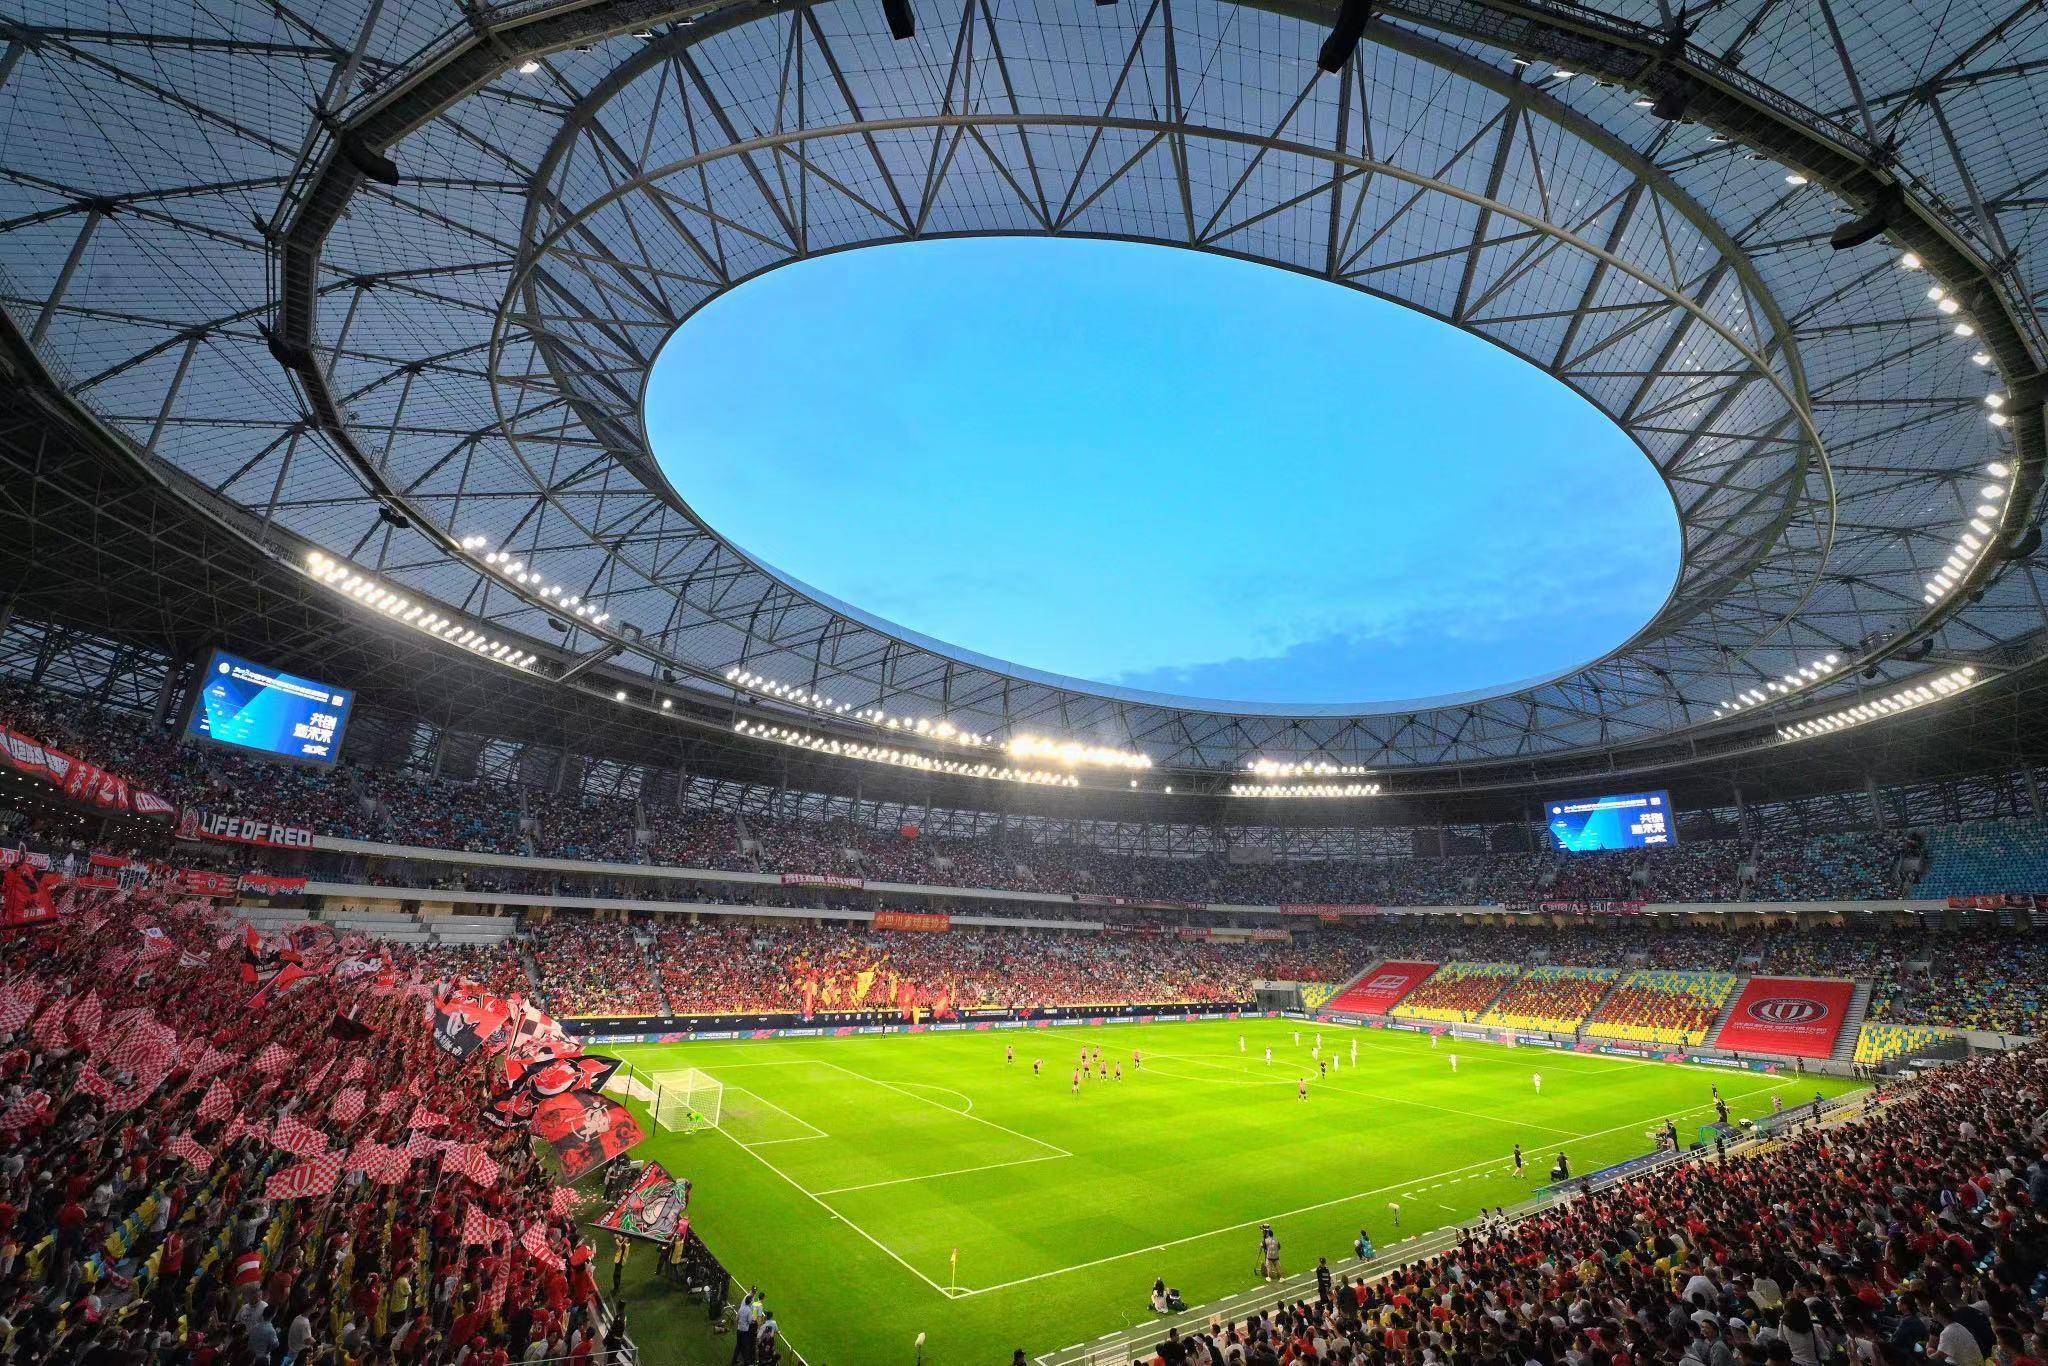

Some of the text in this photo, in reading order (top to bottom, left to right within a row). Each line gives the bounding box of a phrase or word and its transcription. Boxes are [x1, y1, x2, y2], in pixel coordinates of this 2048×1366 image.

[202, 811, 312, 847] LIFE OF RED
[1264, 981, 1272, 989] 2
